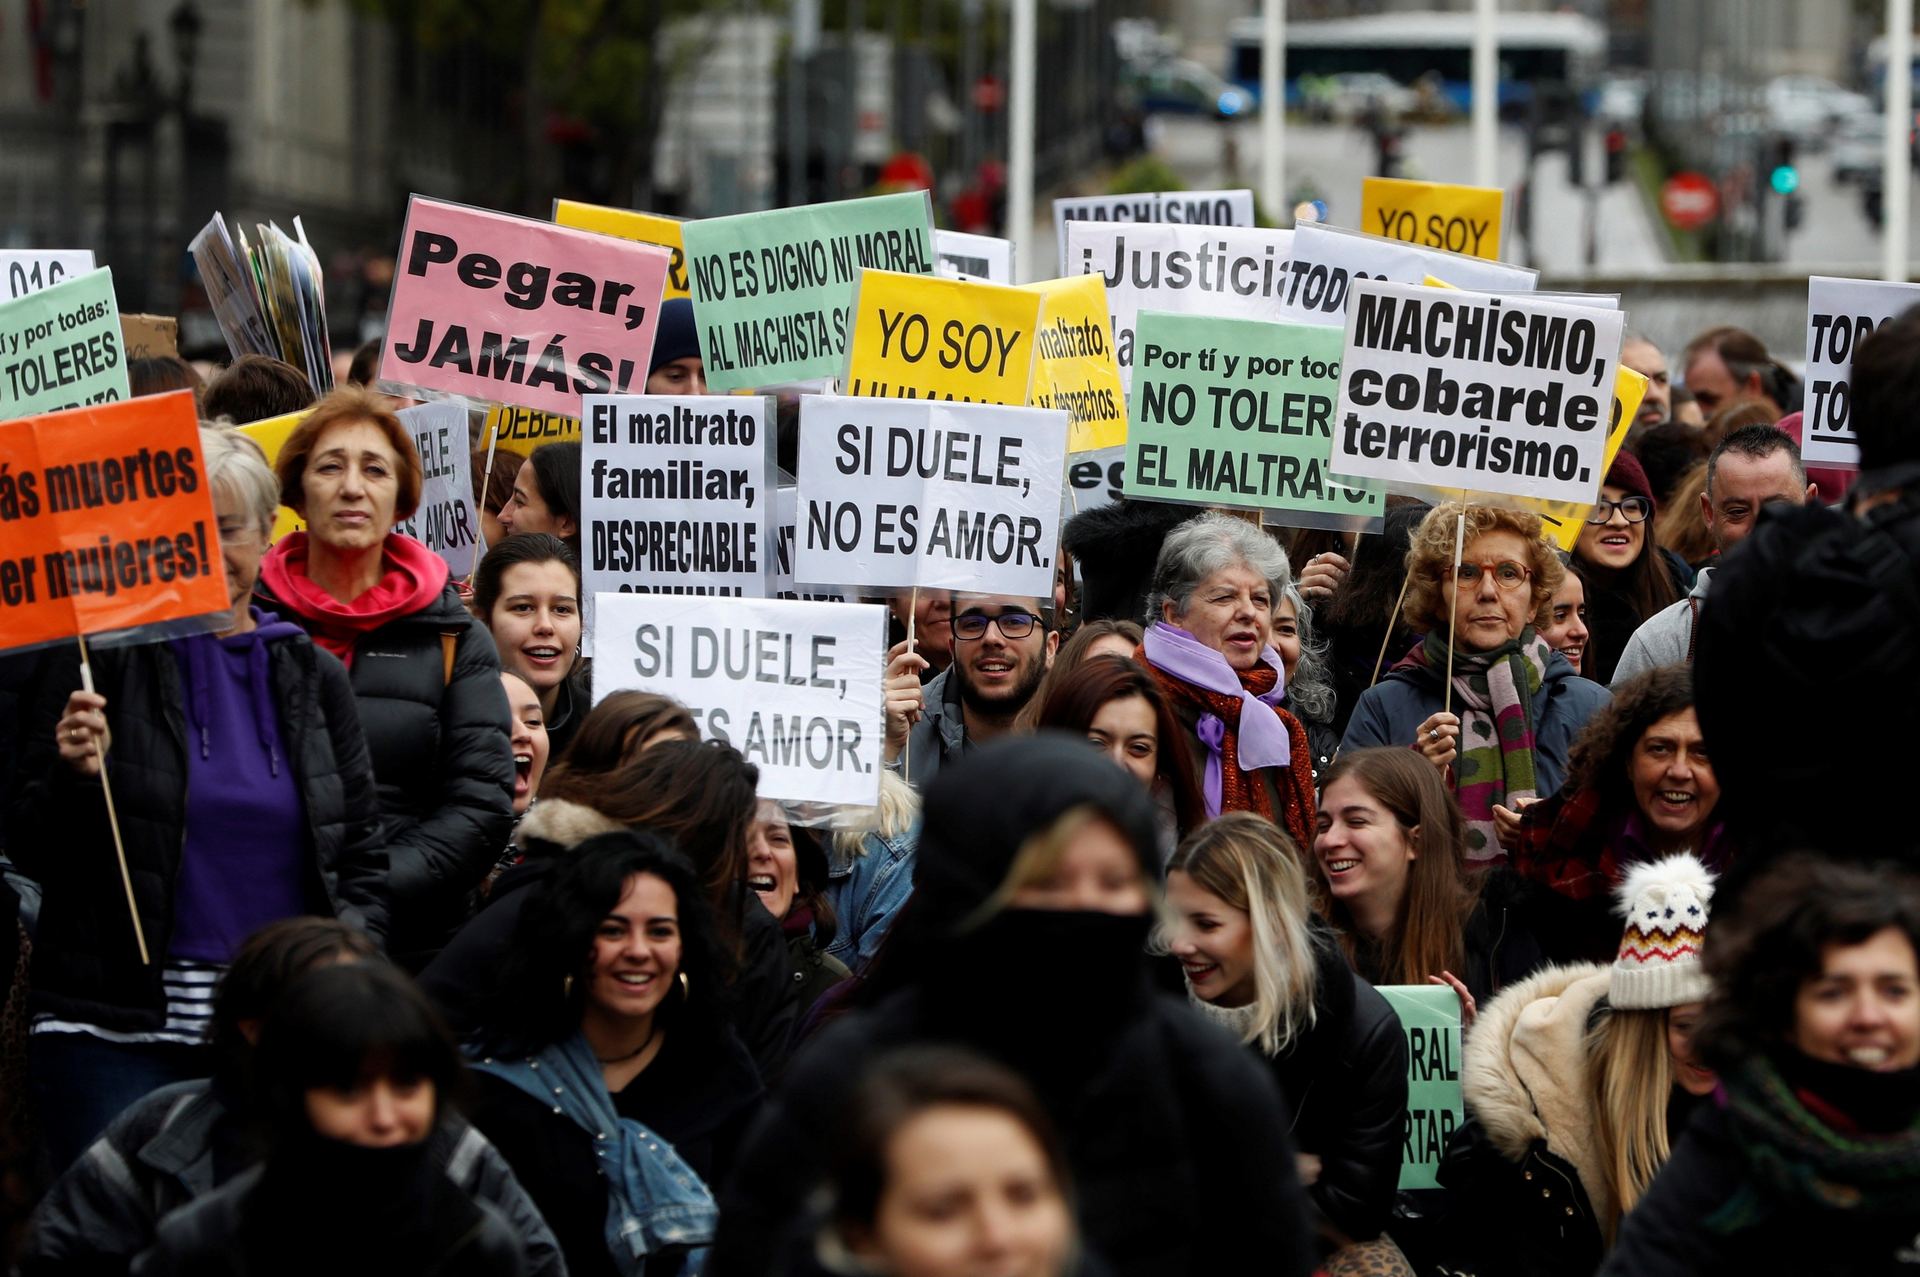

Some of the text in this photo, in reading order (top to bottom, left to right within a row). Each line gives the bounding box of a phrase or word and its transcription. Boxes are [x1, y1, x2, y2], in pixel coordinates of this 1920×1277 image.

[1378, 208, 1489, 257] YO SOY
[408, 230, 646, 331] Pegar,
[694, 254, 727, 303] NO
[729, 250, 758, 298] ES
[761, 239, 828, 294] DIGNO
[830, 236, 854, 284] NI
[855, 227, 933, 274] MORAL
[24, 320, 54, 349] por
[58, 299, 110, 332] todas:
[708, 306, 850, 372] AL MACHISTA S
[878, 308, 1021, 377] YO SOY
[1039, 315, 1110, 363] maltrato,
[5, 331, 118, 401] TOLERES
[394, 318, 636, 396] JAMÁS!
[1144, 344, 1191, 369] Por
[1198, 349, 1217, 371] tí
[1223, 355, 1240, 379] y
[1247, 356, 1294, 379] por
[497, 406, 572, 441] DEBEN
[592, 405, 756, 447] El maltrato
[1141, 381, 1333, 438] NO TOLER
[1348, 367, 1599, 432] cobarde
[835, 424, 1031, 499] SI DUELE,
[1136, 443, 1177, 487] EL
[1343, 412, 1591, 483] terrorismo.
[44, 448, 198, 513] muertes
[591, 459, 755, 509] familiar,
[426, 498, 480, 553] AMOR.
[592, 519, 757, 574] DESPRECIABLE
[807, 500, 862, 552] NO
[873, 504, 919, 555] ES
[926, 508, 1050, 568] AMOR.
[43, 521, 211, 600] mujeres!
[634, 623, 847, 700] SI DUELE,
[743, 711, 873, 774] AMOR.
[1401, 1027, 1458, 1081] RAL
